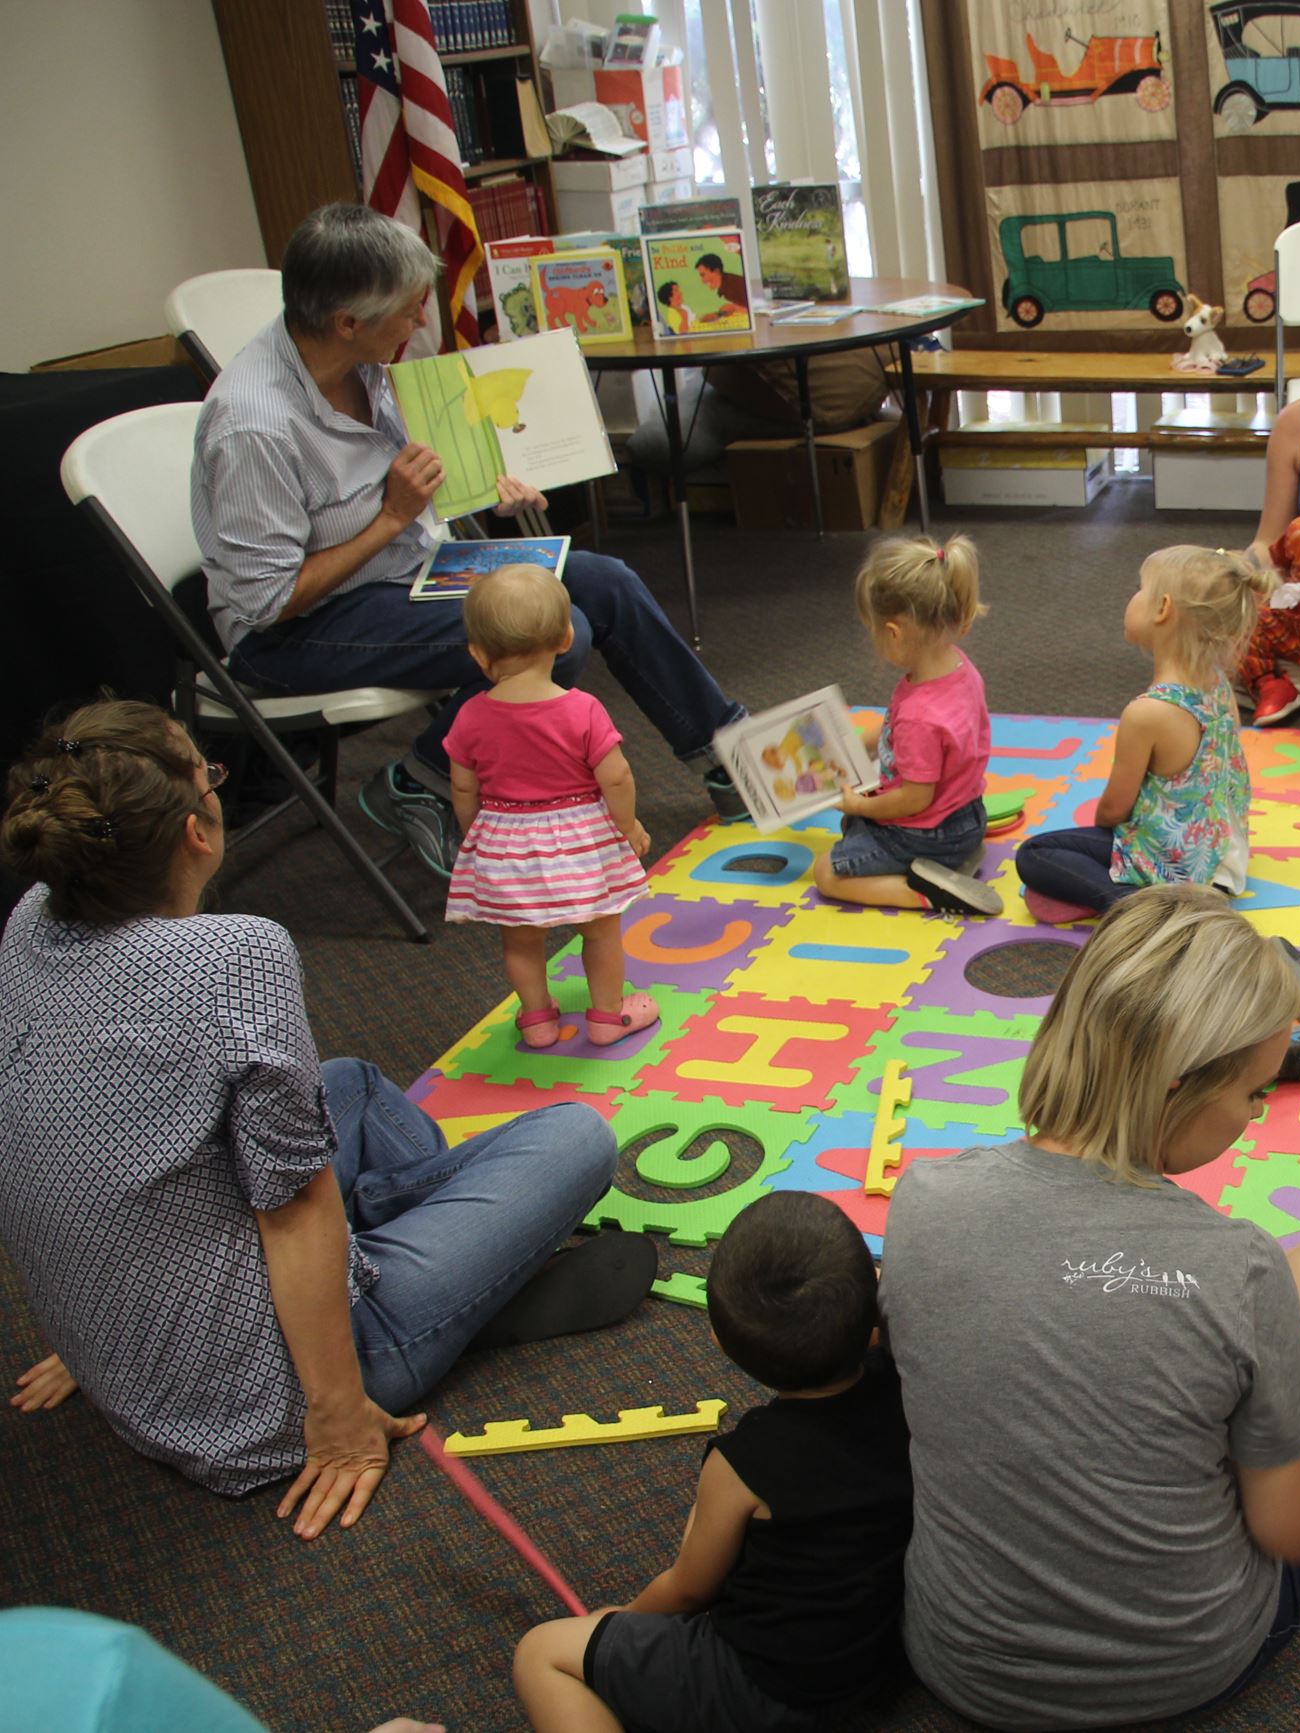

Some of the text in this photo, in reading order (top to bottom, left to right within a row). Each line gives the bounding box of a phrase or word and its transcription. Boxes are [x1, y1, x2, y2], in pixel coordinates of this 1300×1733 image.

[652, 256, 688, 270] Kind
[1060, 1251, 1161, 1292] ruby's
[1130, 1283, 1191, 1299] RUBBISH
